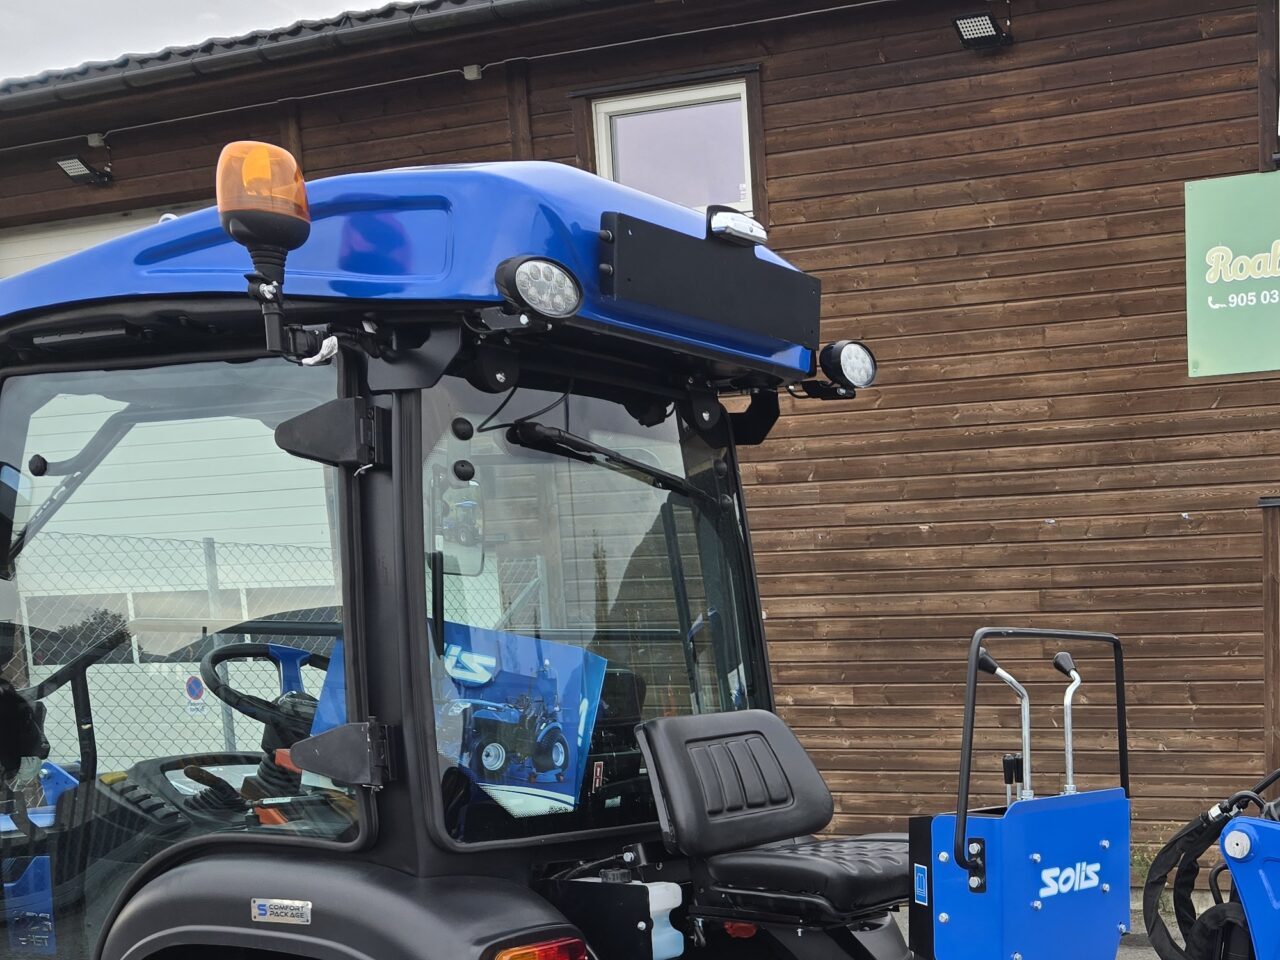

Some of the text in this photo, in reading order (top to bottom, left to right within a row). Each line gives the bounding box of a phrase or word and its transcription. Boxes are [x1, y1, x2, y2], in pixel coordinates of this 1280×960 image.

[1228, 294, 1256, 308] 905
[1260, 292, 1279, 305] 03
[1038, 861, 1101, 899] Solis
[269, 904, 304, 912] COMFORT
[270, 911, 304, 919] PACKAGE
